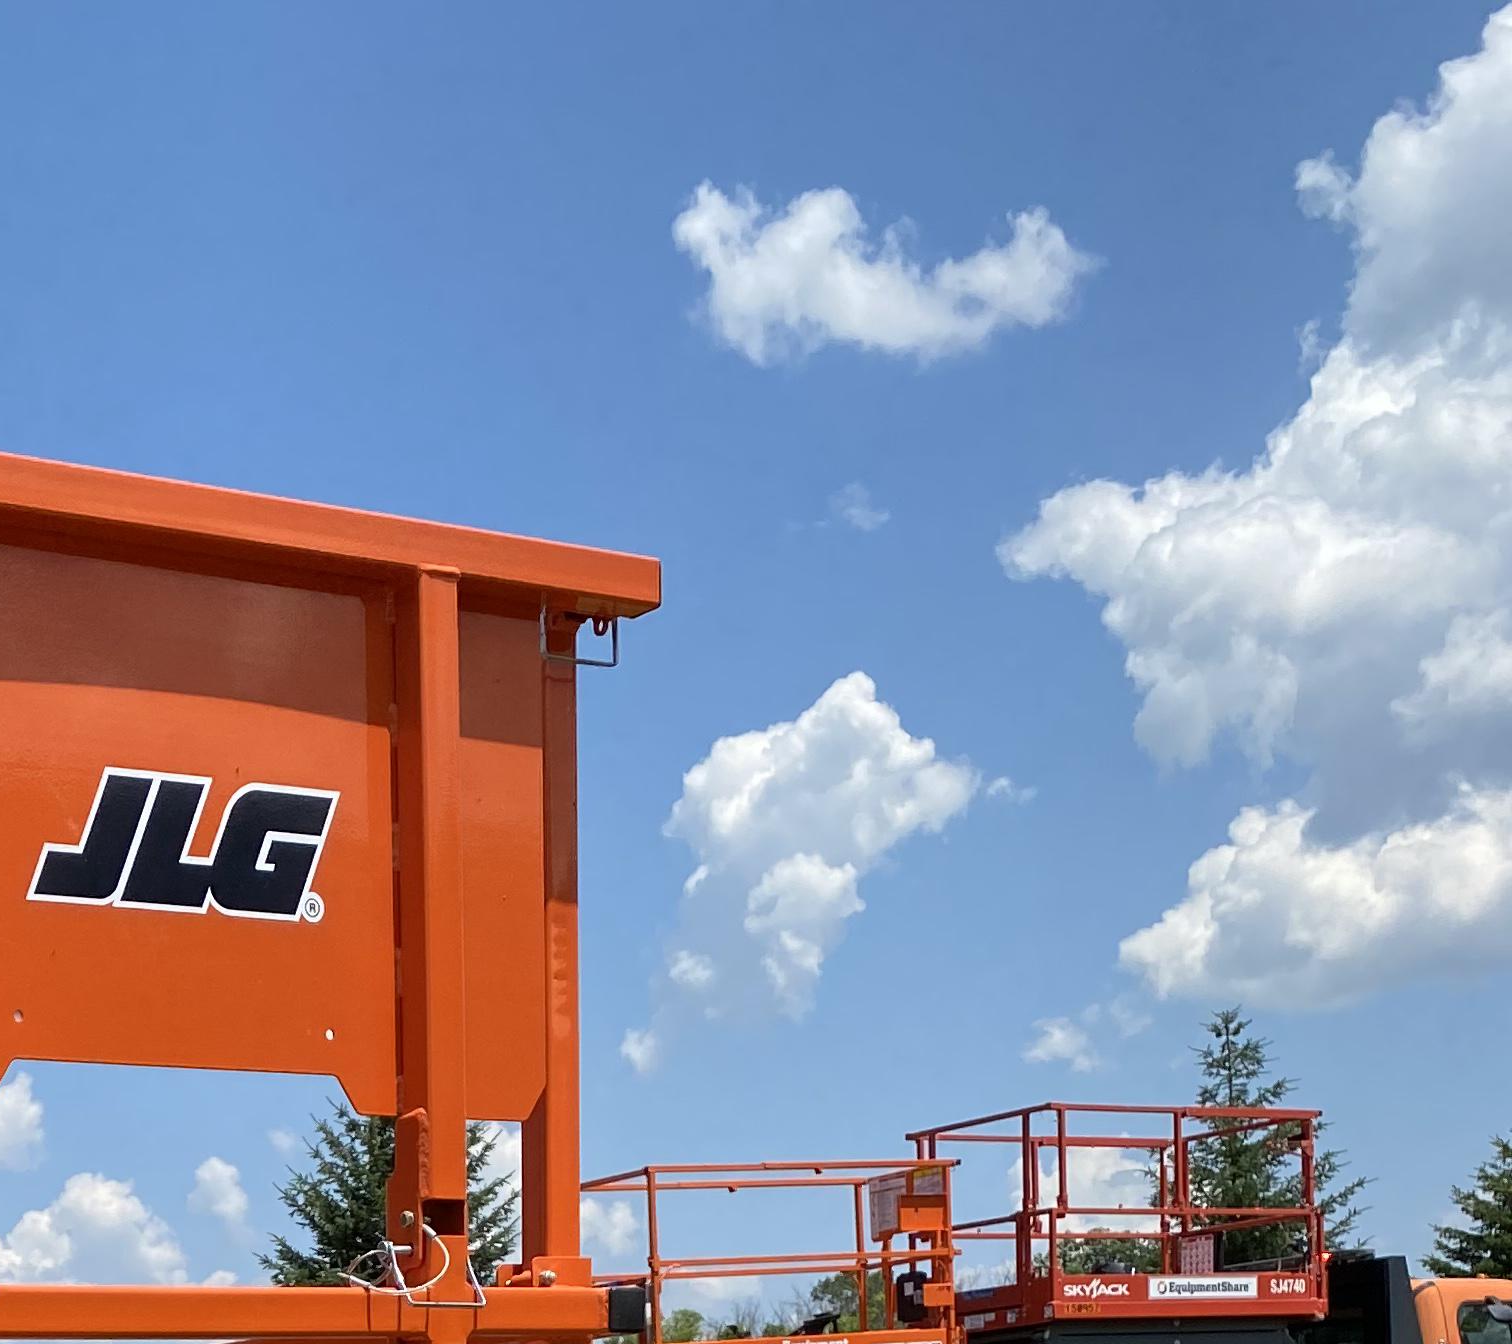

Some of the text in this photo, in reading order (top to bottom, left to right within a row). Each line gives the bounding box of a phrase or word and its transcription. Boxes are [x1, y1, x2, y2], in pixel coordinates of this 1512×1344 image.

[26, 766, 340, 921] JLG
[1063, 1278, 1130, 1299] SKYJACK
[1169, 1281, 1249, 1295] EquipmentShare
[1270, 1278, 1306, 1294] SJ4740
